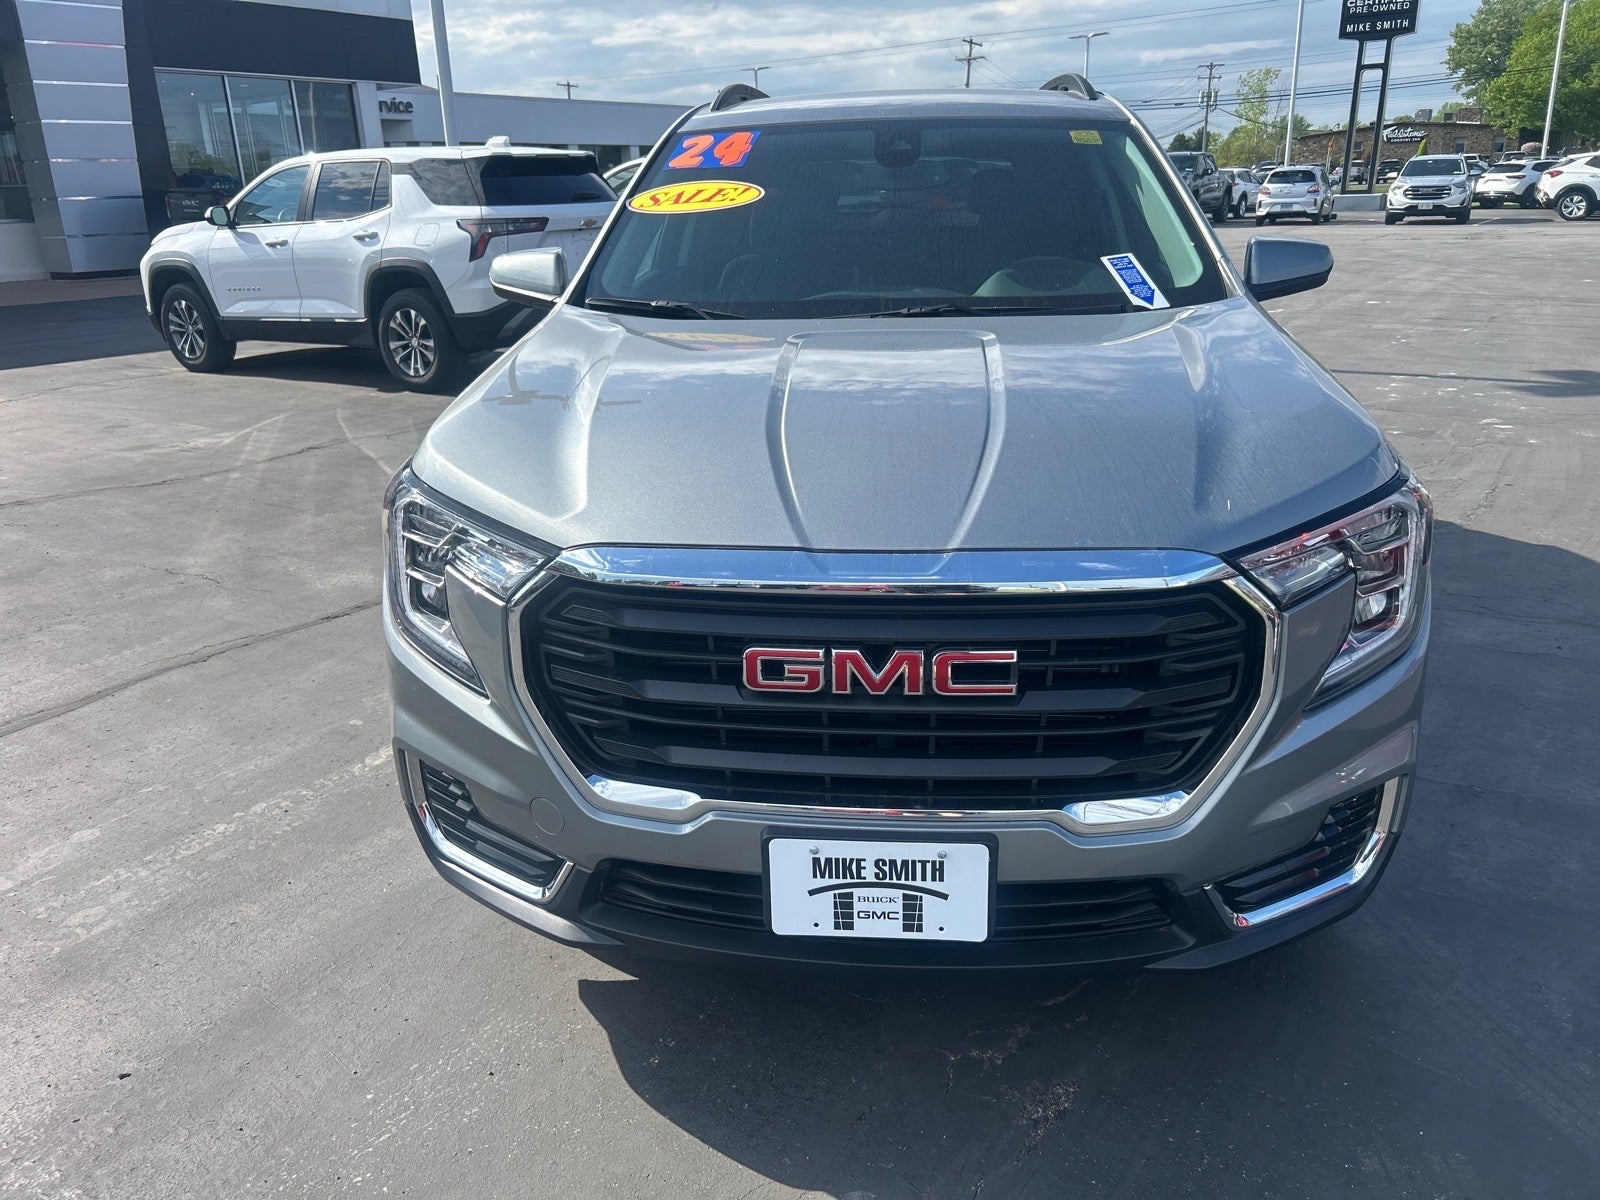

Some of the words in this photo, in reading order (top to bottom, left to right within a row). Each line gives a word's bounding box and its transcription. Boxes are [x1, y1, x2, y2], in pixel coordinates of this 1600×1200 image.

[1349, 2, 1410, 14] PRE-OWNED
[1346, 22, 1371, 33] MIKE
[1376, 19, 1409, 30] SMITH
[378, 97, 414, 114] rvice
[668, 131, 755, 169] 24
[640, 186, 752, 208] SALE!
[742, 648, 1017, 696] GMC
[811, 856, 867, 881] MIKE
[873, 858, 945, 883] SMITH
[857, 896, 898, 904] BUICK
[857, 910, 900, 921] GMC
